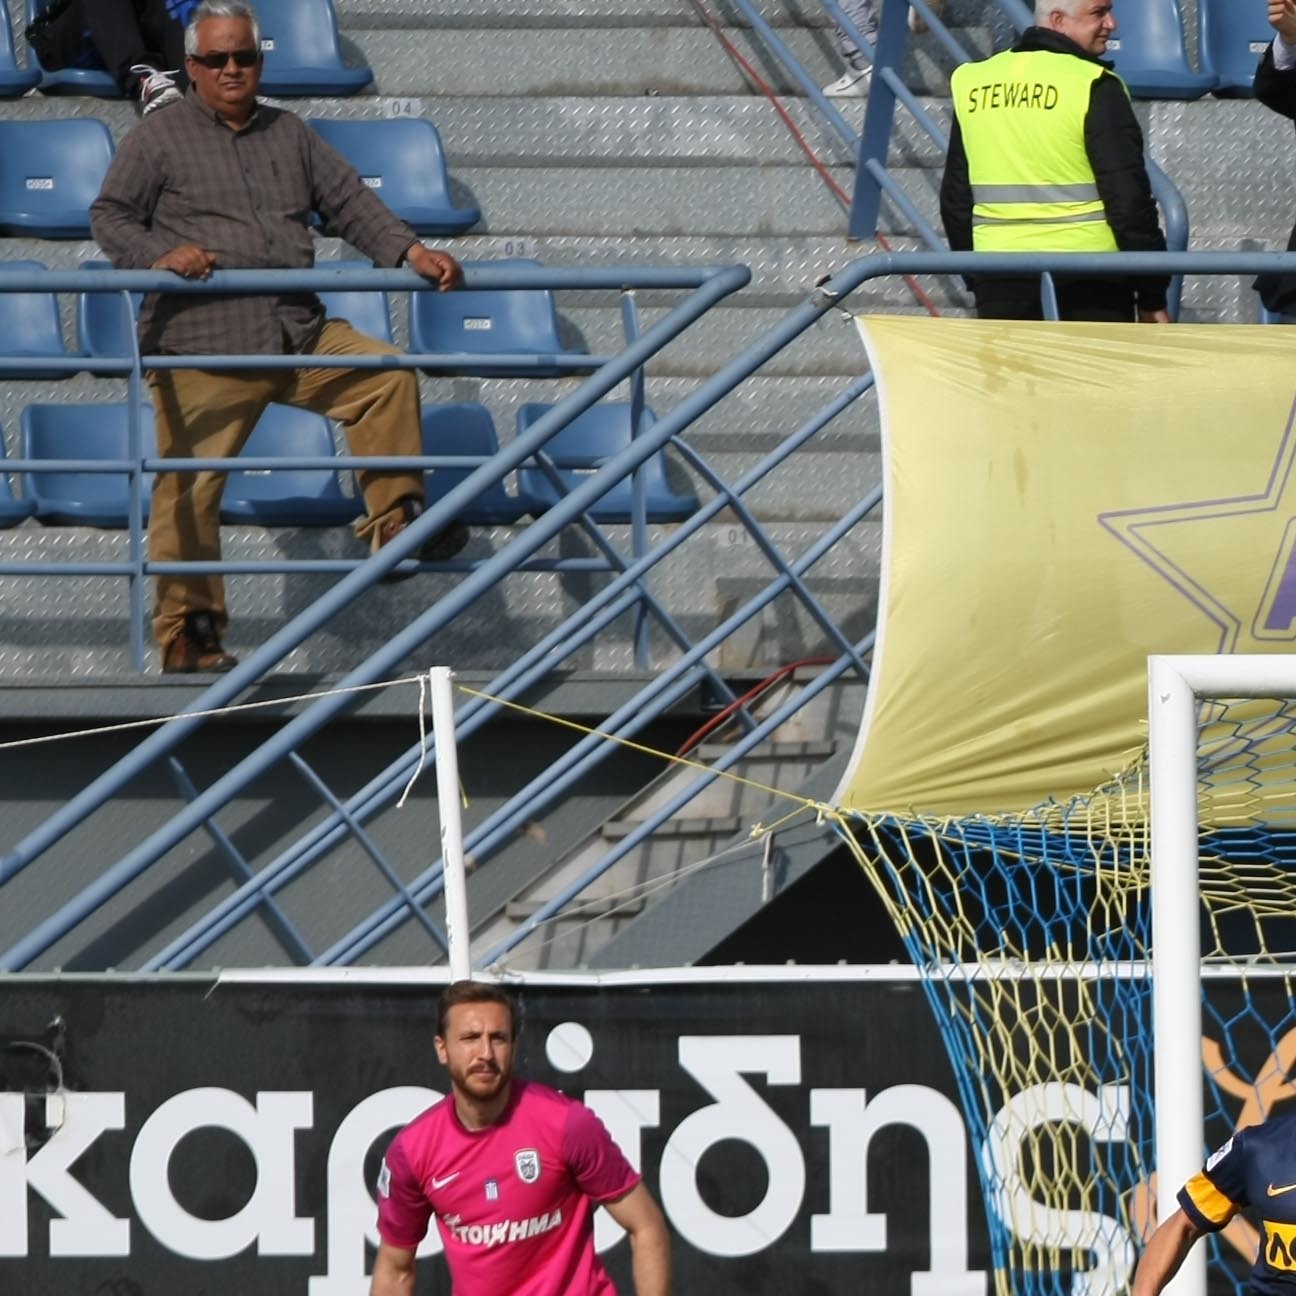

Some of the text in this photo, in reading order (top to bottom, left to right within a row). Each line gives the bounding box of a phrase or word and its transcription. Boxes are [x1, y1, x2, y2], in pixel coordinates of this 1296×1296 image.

[967, 82, 1059, 114] STEWARD
[392, 101, 412, 114] 04
[504, 241, 526, 256] 03
